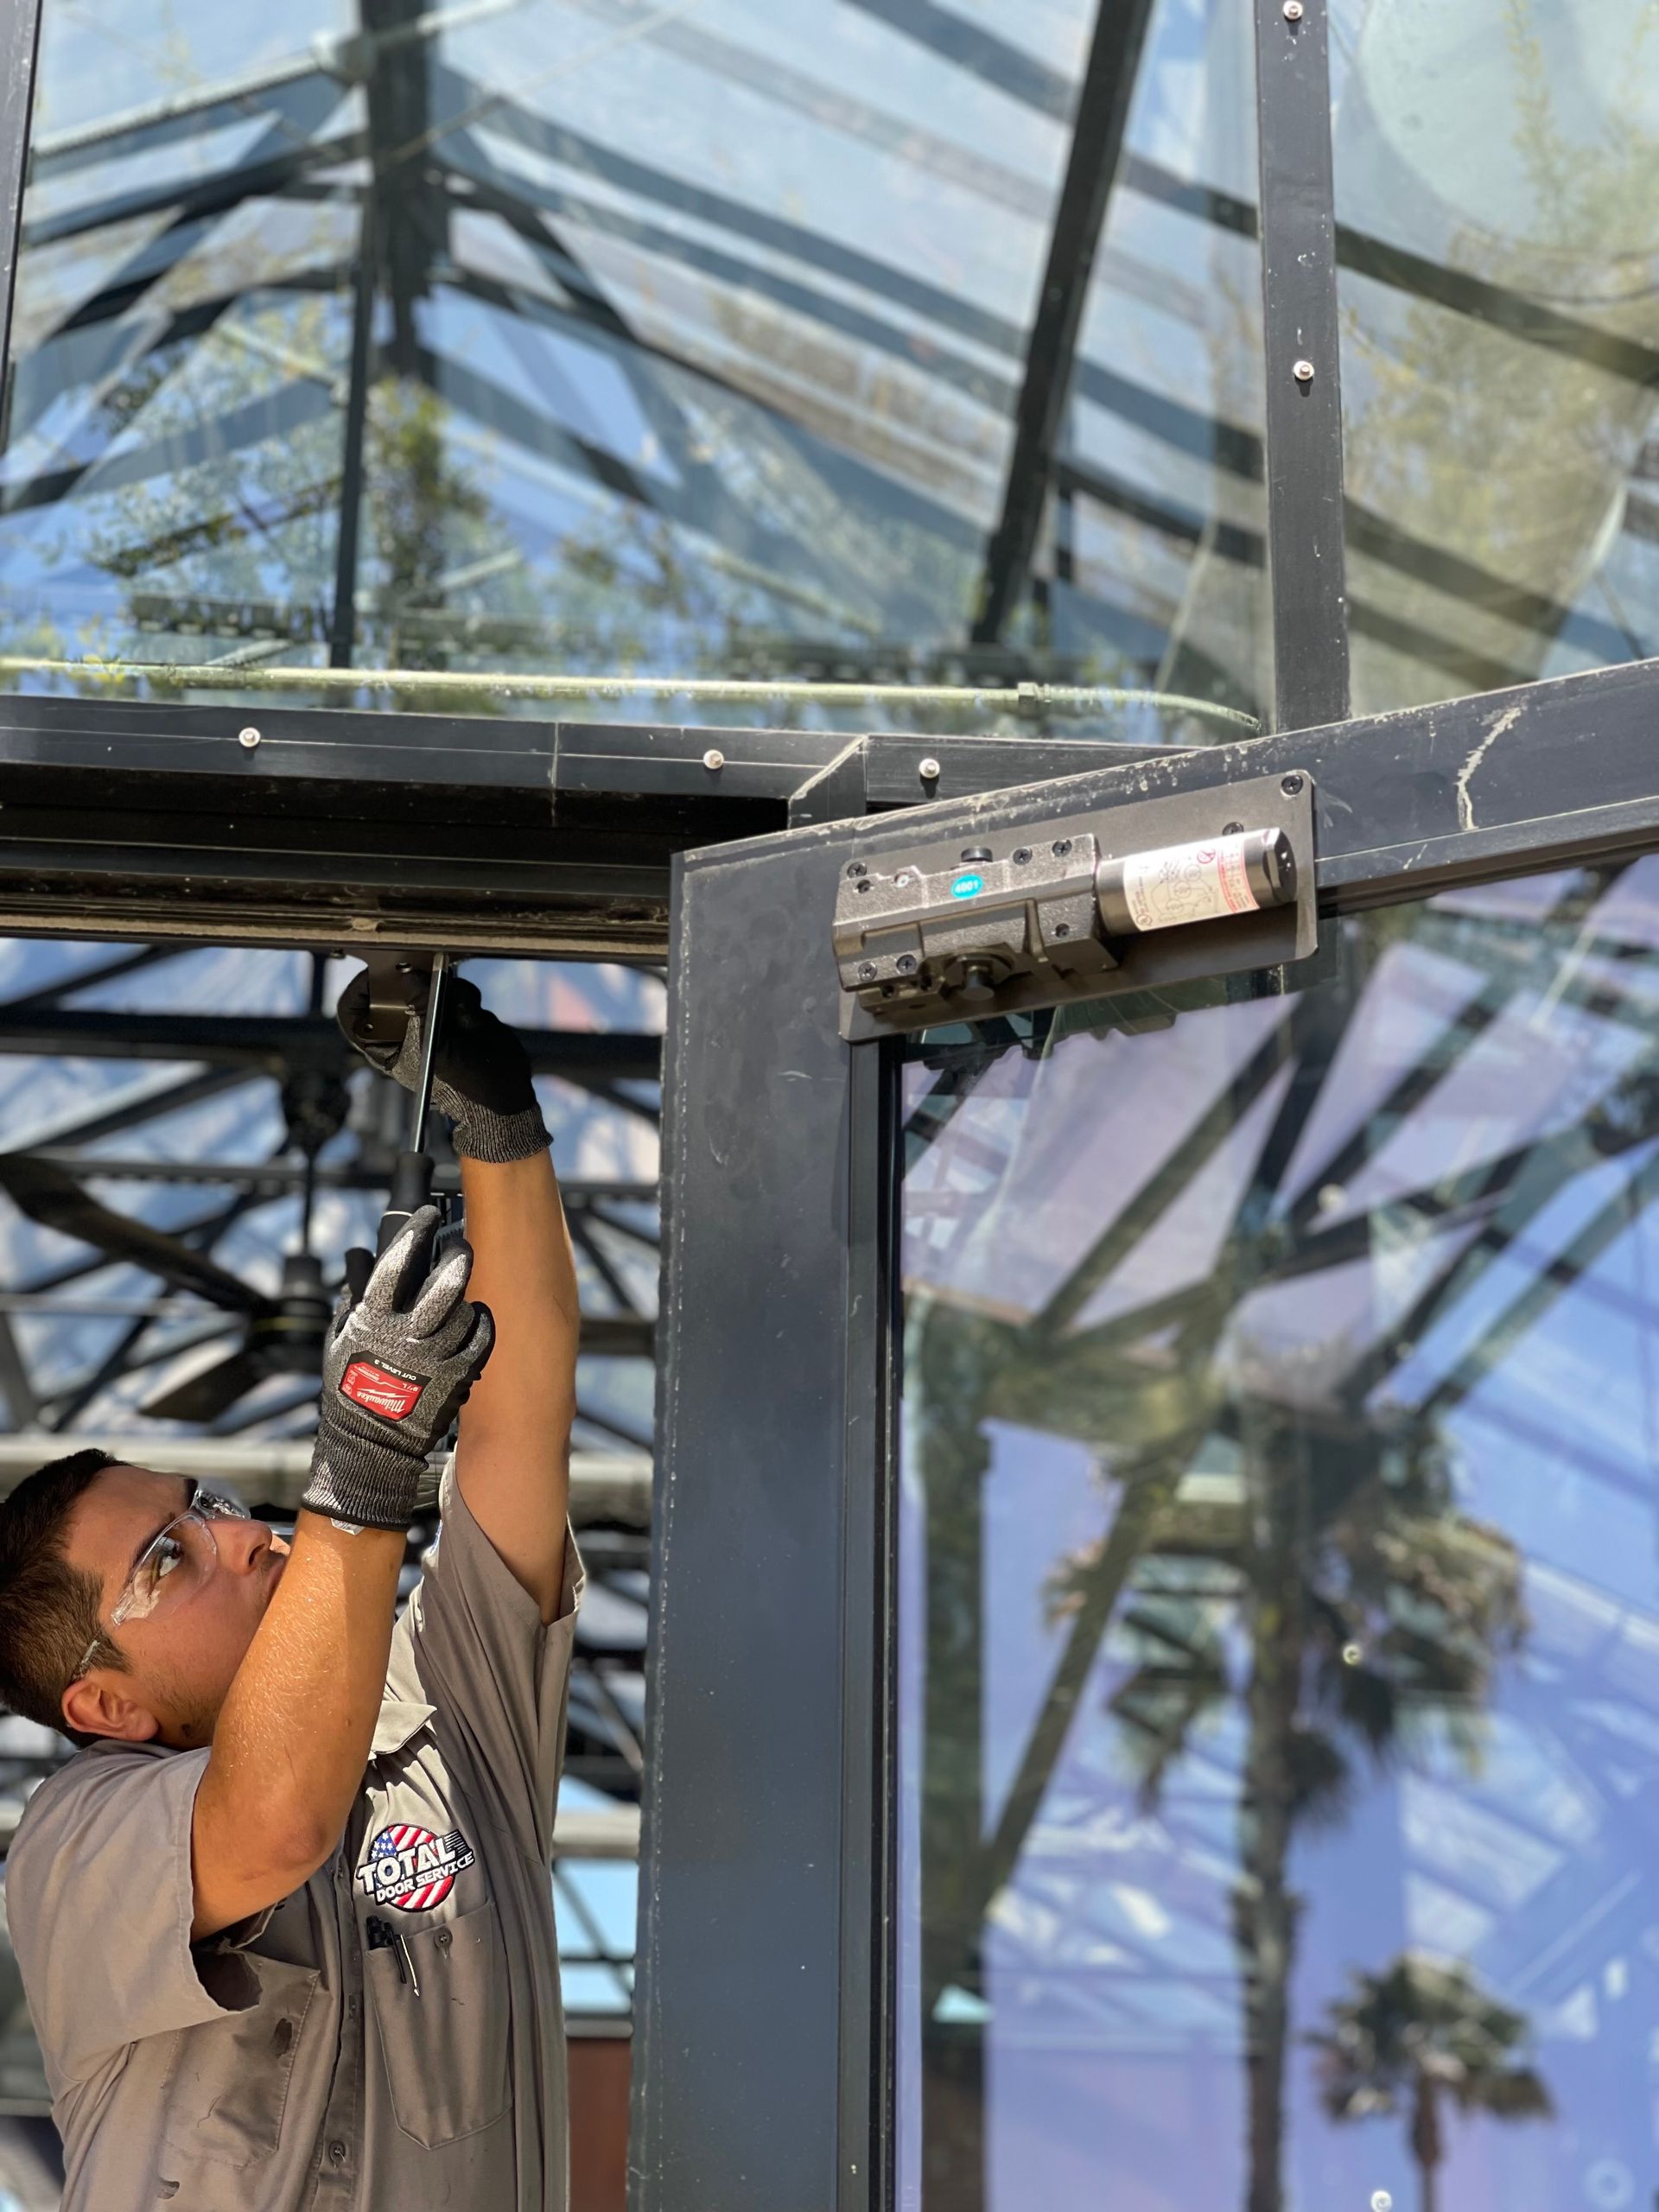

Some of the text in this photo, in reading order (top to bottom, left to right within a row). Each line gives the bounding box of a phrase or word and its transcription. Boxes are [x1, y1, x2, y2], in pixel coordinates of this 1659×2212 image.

[381, 1362, 400, 1375] LEVEL
[400, 1372, 416, 1381] CUT
[356, 1390, 405, 1414] Milwaukee
[358, 1837, 455, 1892] TOTAL
[376, 1851, 474, 1903] DOOR SERVICE
